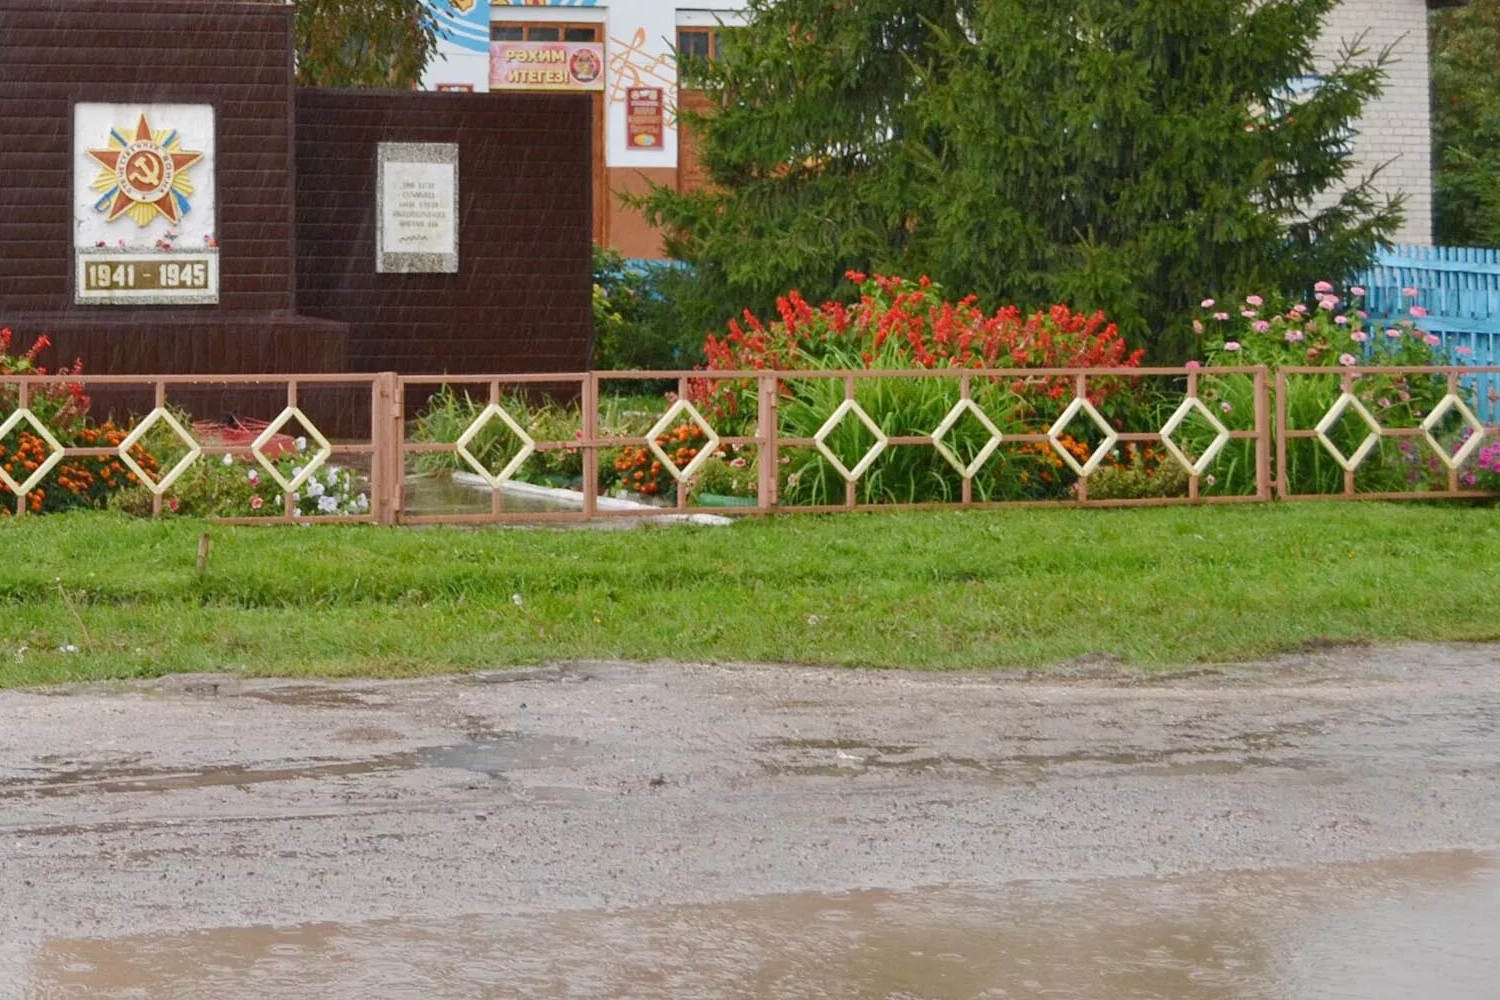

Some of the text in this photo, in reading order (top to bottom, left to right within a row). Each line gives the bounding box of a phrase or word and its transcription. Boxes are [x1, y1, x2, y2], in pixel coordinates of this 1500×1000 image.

[505, 49, 567, 64] РӘХИМ
[507, 70, 570, 85] ИТЕГЕЗ!
[89, 264, 135, 287] 1941
[159, 263, 205, 287] 1945
